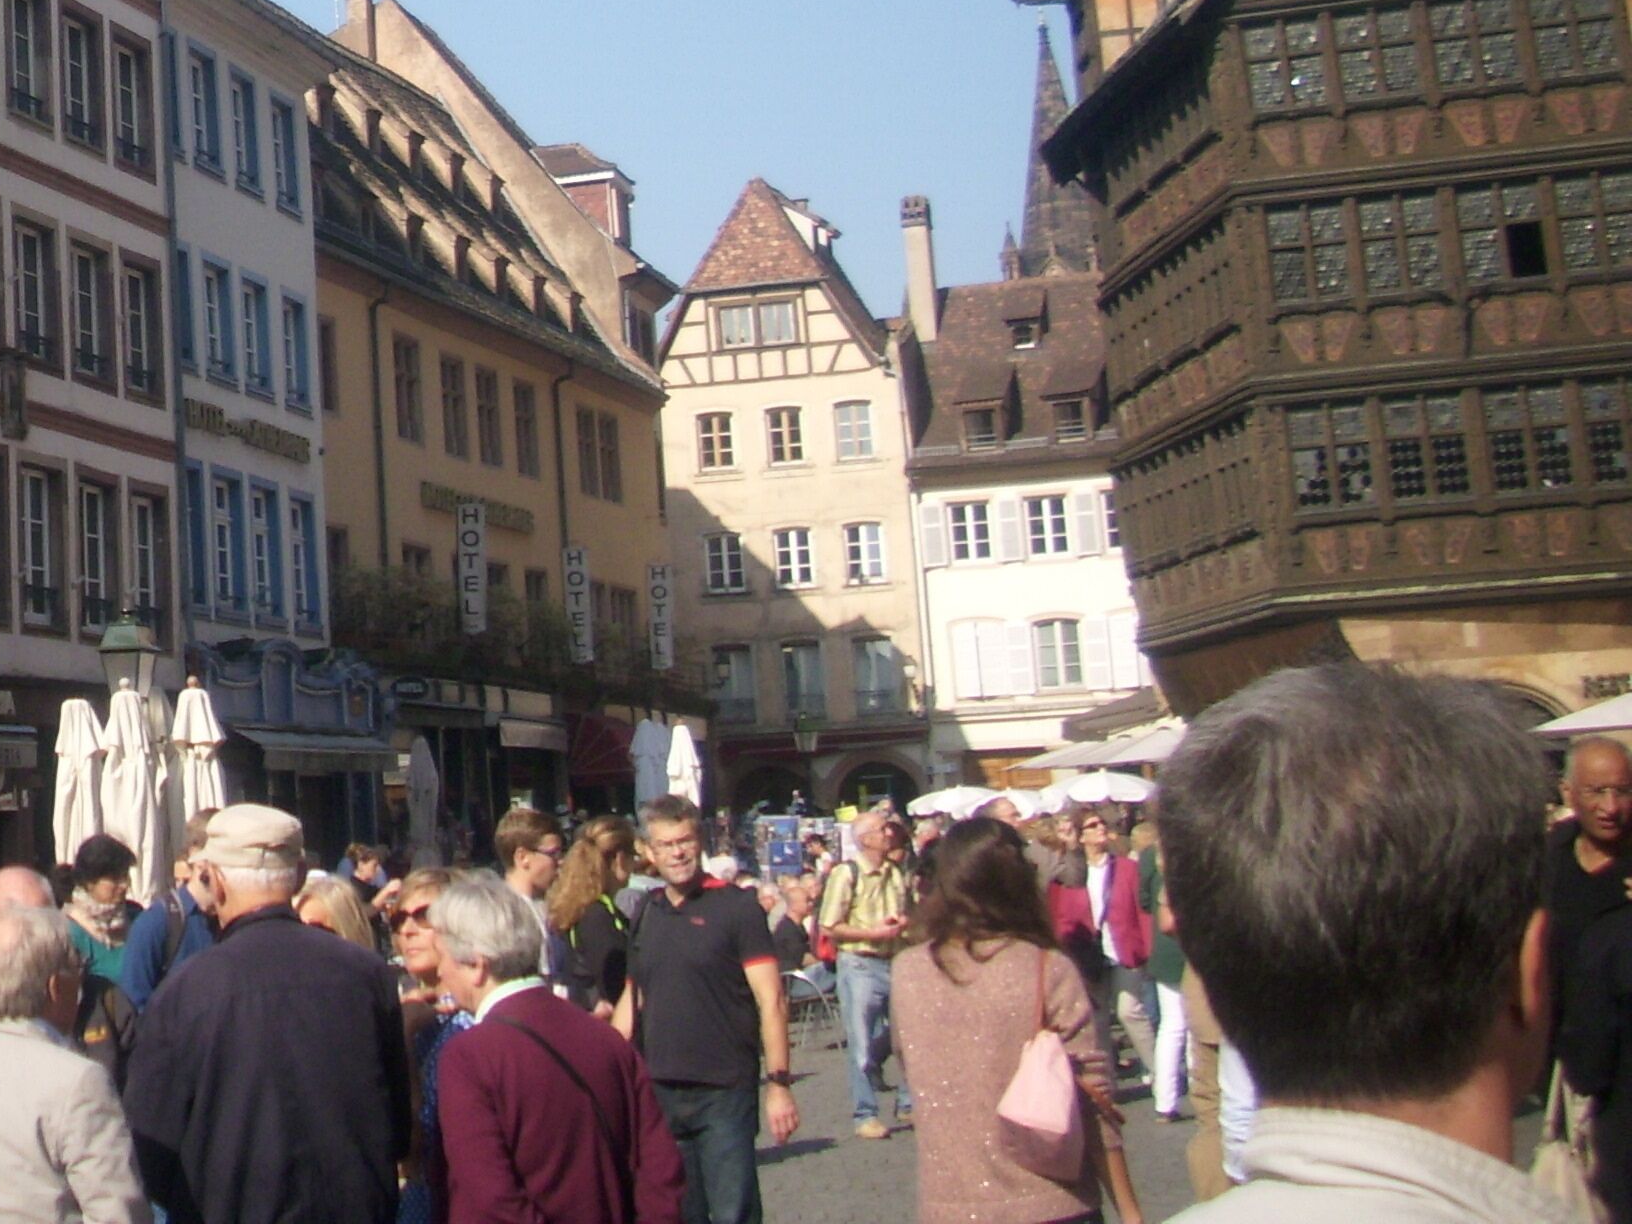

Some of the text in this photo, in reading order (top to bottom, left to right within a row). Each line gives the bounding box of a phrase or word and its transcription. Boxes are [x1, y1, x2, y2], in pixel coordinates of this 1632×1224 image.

[461, 507, 480, 616] HOTEL
[567, 550, 587, 648] HOTEL
[650, 566, 668, 656] HOTEL
